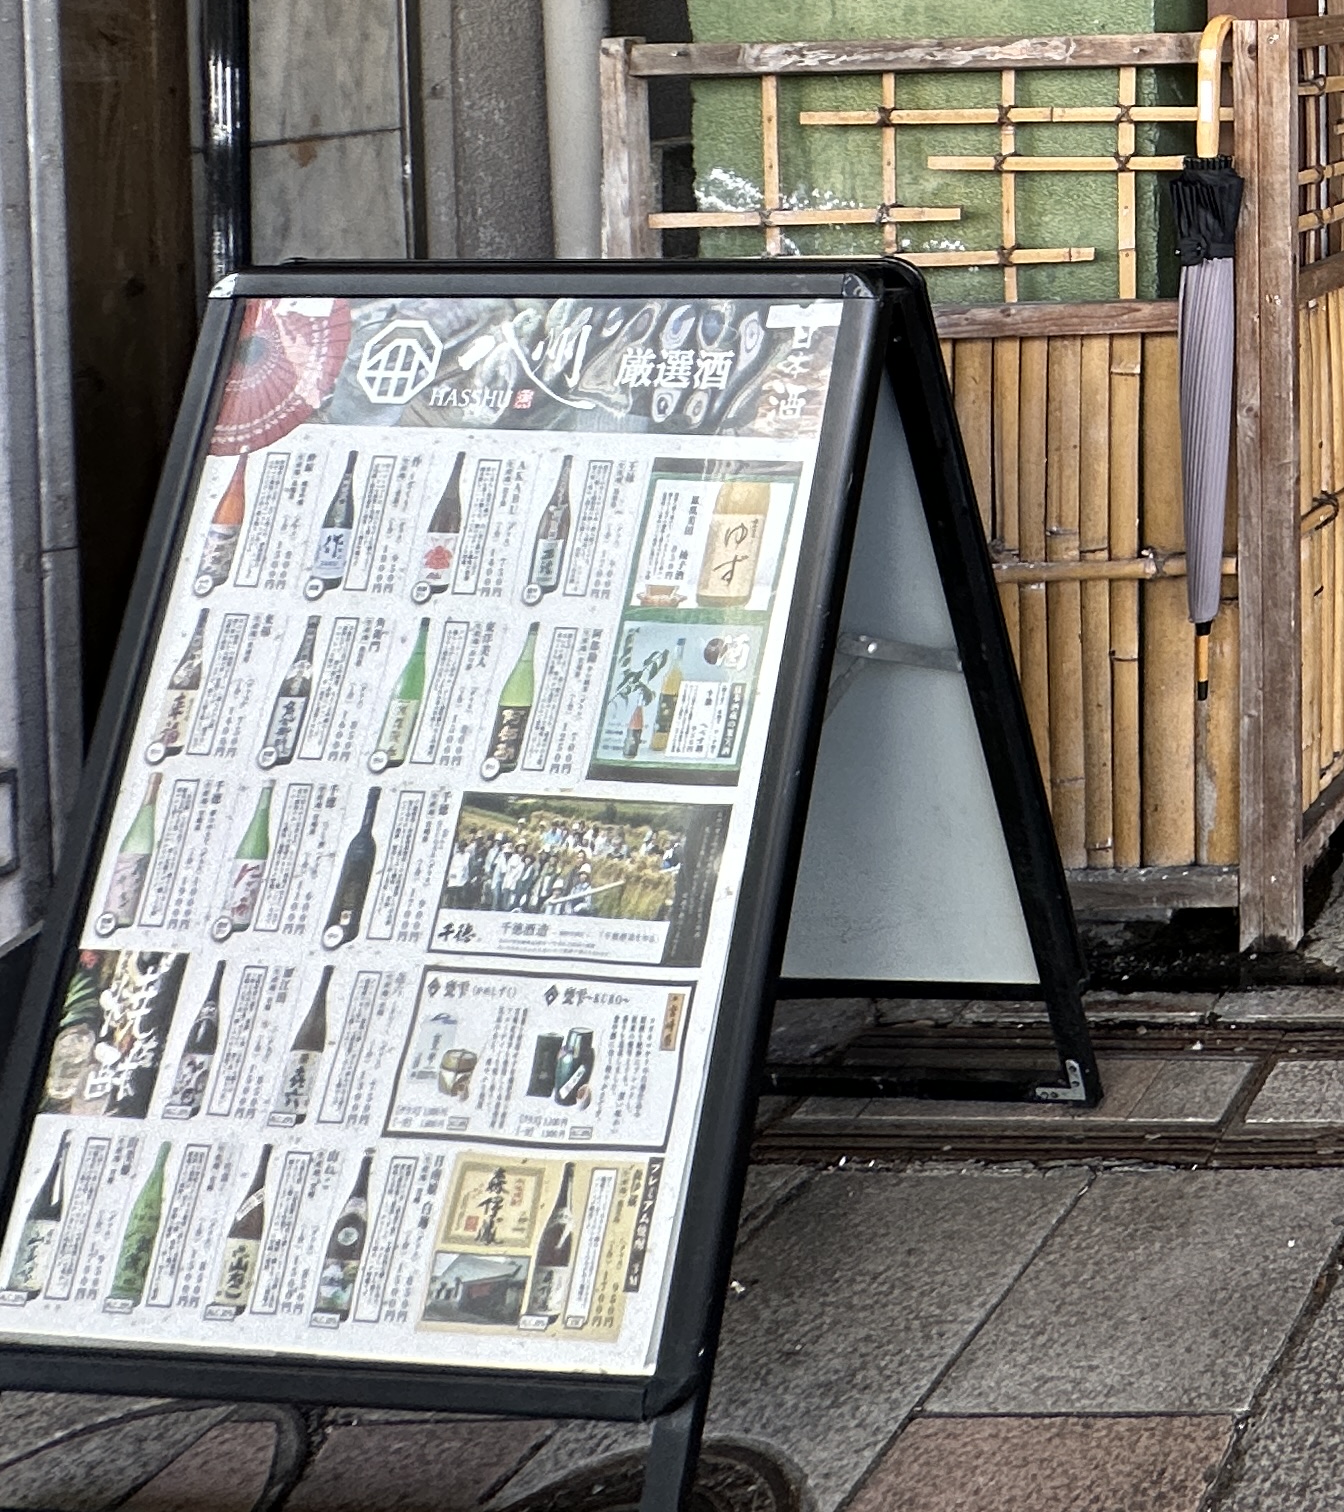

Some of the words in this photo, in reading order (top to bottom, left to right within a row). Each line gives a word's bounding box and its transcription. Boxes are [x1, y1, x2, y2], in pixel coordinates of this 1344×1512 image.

[615, 348, 733, 390] 厳選酒
[429, 388, 512, 407] HASSHU
[710, 523, 755, 585] ゆず
